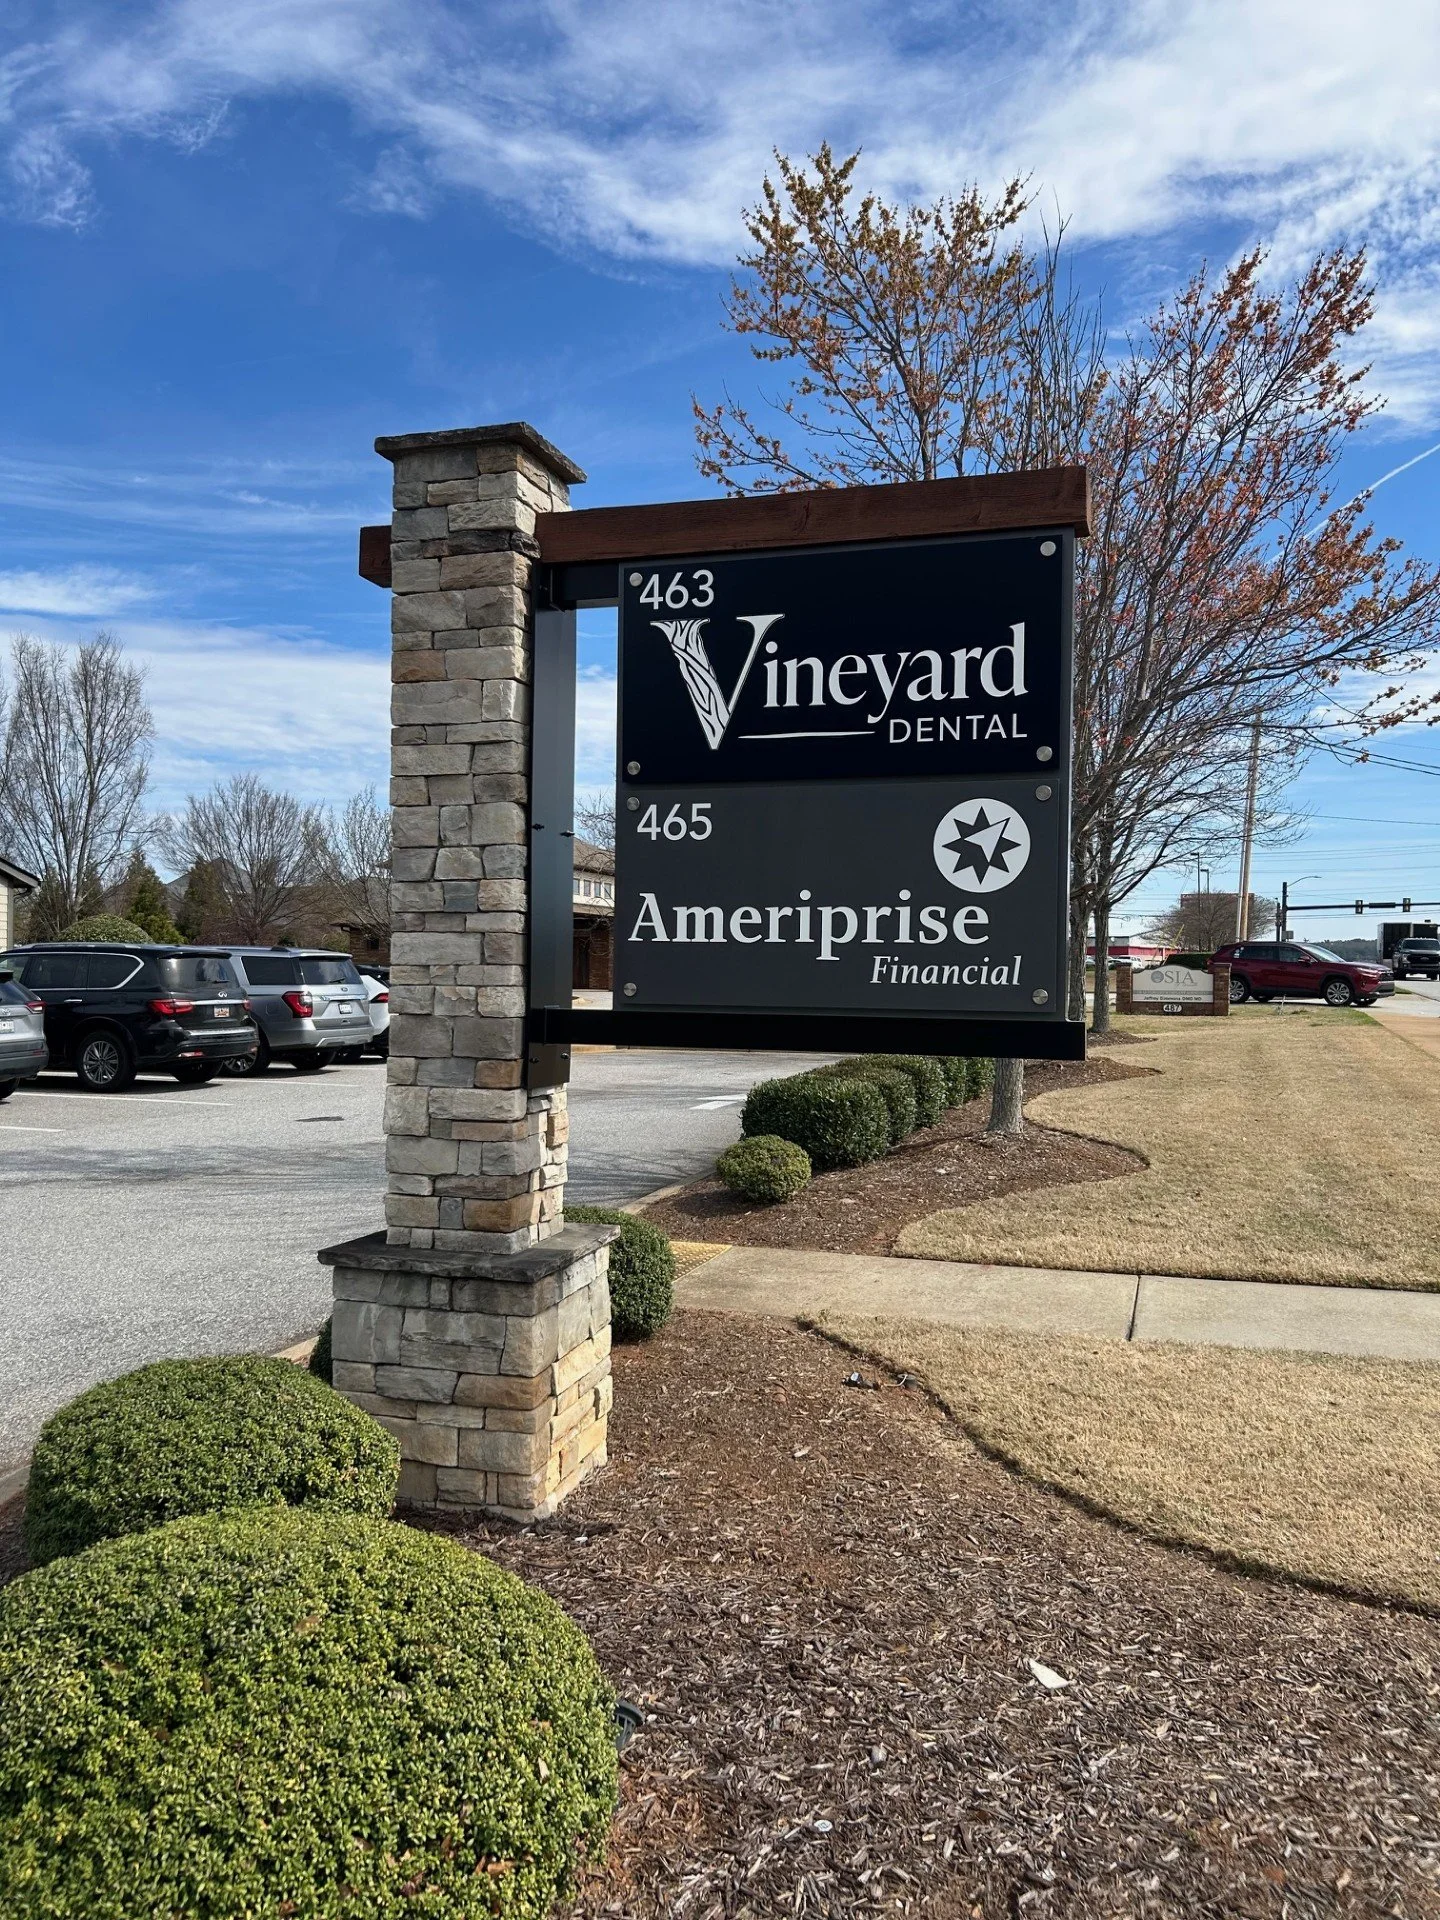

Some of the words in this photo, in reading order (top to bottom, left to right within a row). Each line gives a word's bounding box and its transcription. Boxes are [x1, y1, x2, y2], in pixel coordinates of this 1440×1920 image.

[639, 570, 714, 609] 463
[650, 613, 1029, 750] Vineyard
[889, 714, 1028, 743] DENTAL
[637, 803, 713, 841] 465
[628, 889, 990, 961] Ameriprise
[870, 955, 1022, 986] Financial
